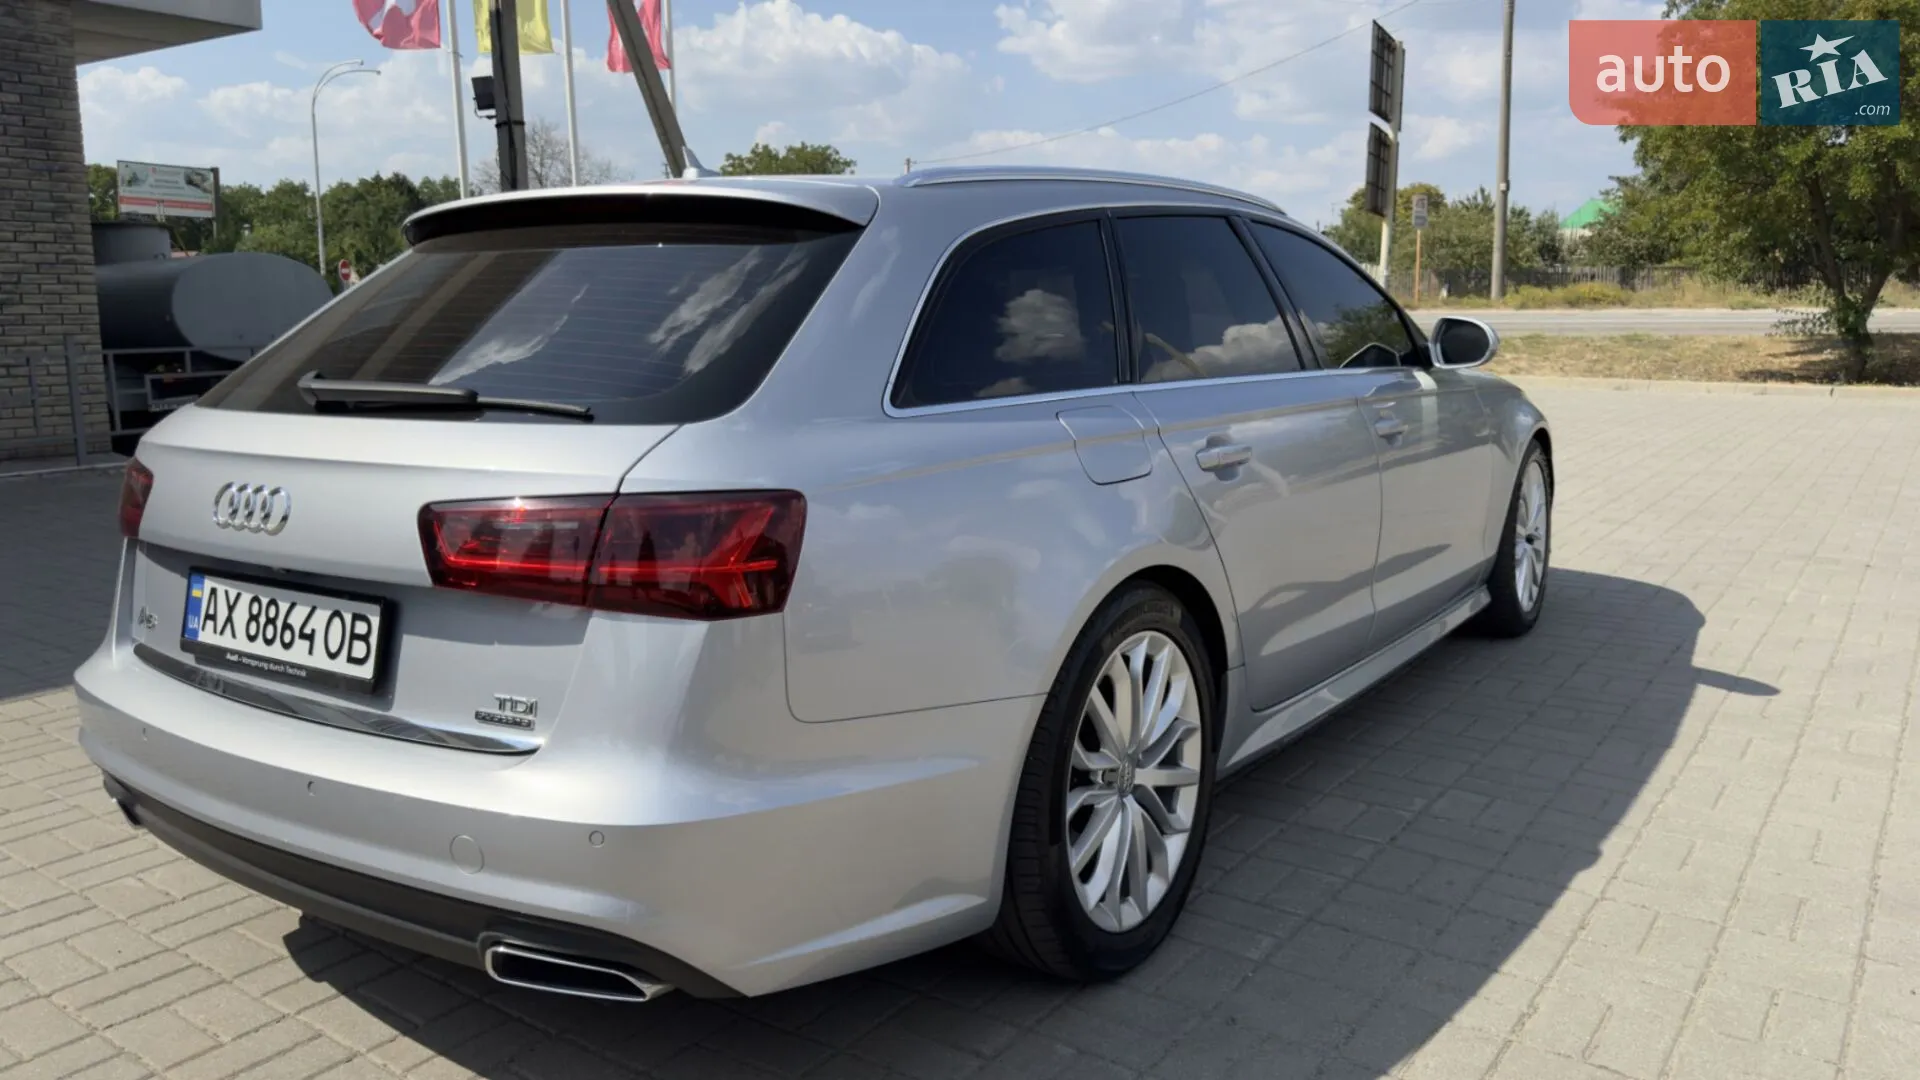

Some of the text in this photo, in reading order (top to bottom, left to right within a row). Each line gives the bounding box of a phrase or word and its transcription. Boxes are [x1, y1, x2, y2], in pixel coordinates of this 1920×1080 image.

[187, 614, 199, 629] UA
[201, 586, 372, 666] AX 8864 OB
[493, 693, 538, 718] TDI
